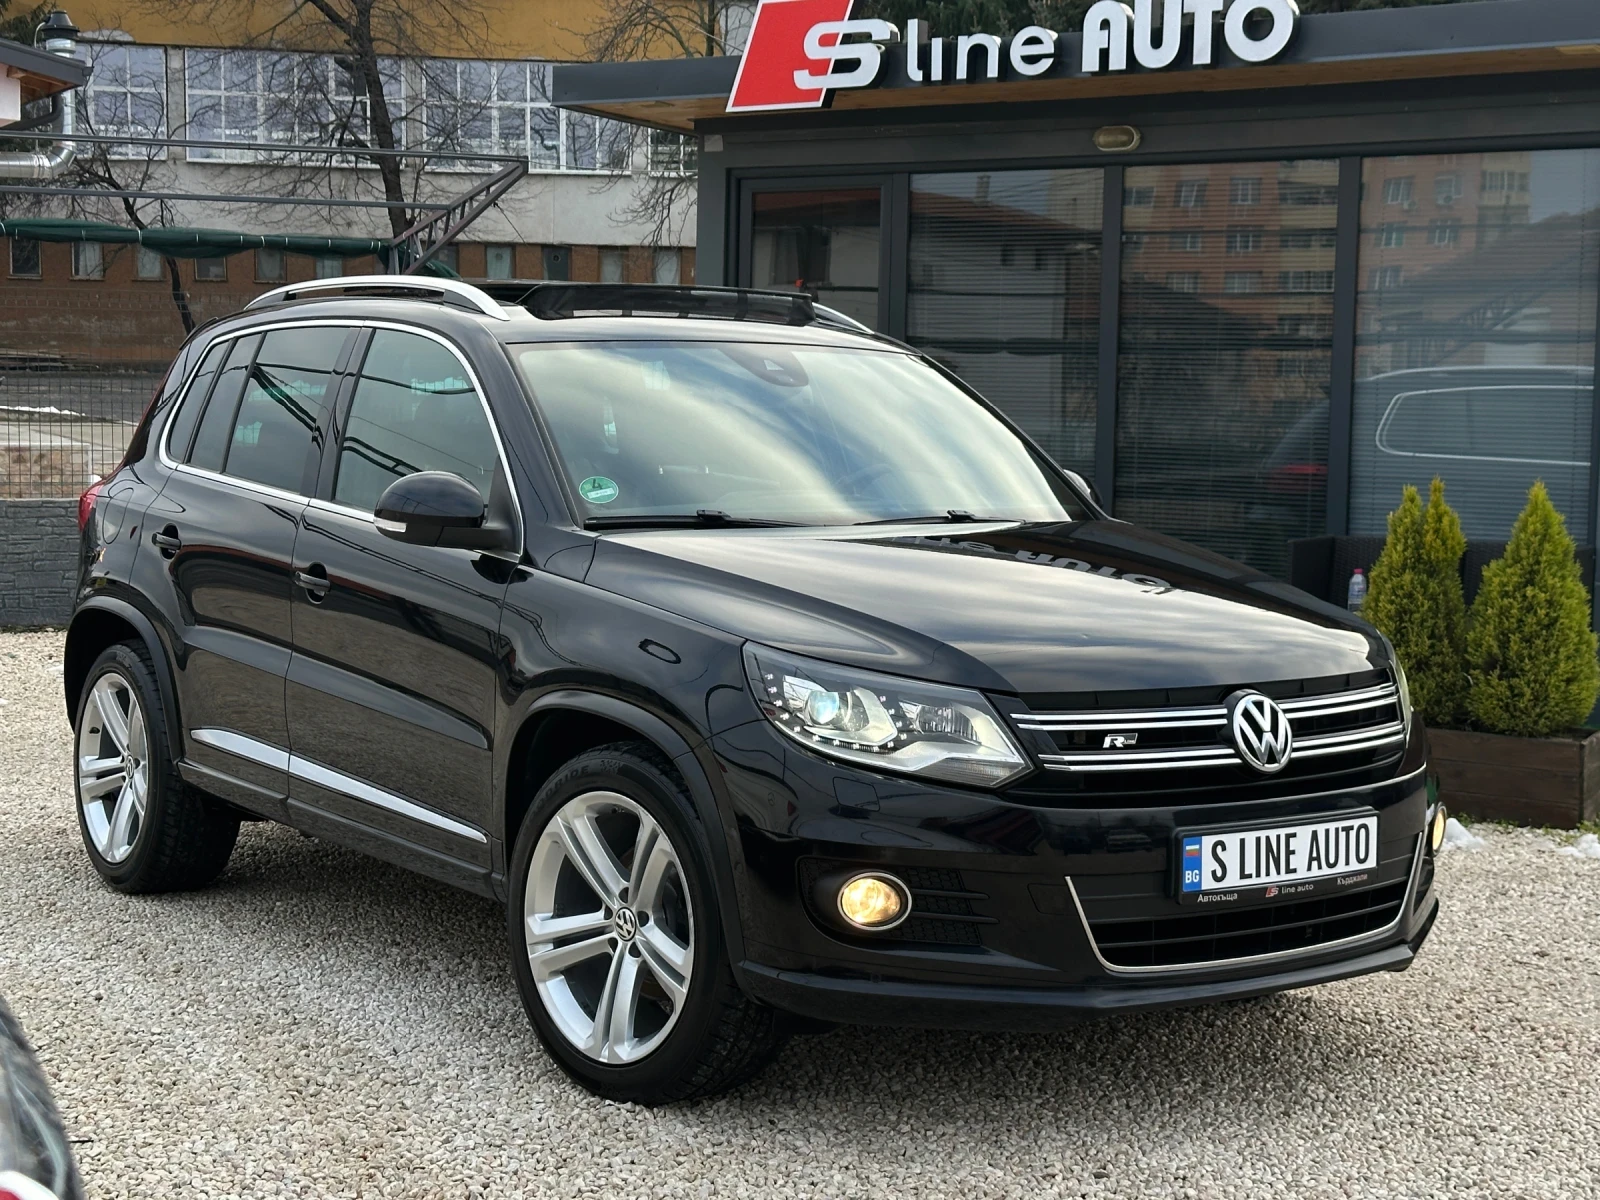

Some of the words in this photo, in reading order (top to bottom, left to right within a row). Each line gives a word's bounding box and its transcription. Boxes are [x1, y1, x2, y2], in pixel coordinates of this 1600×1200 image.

[793, 19, 890, 90] S
[907, 18, 1055, 81] line
[1082, 0, 1295, 72] AUTO
[1211, 839, 1227, 883] S
[1239, 832, 1297, 880] LINE
[1306, 823, 1370, 872] AUTO
[1185, 870, 1200, 884] BG
[1281, 886, 1296, 894] line
[1297, 884, 1314, 892] auto
[1197, 893, 1238, 903] Автокъща
